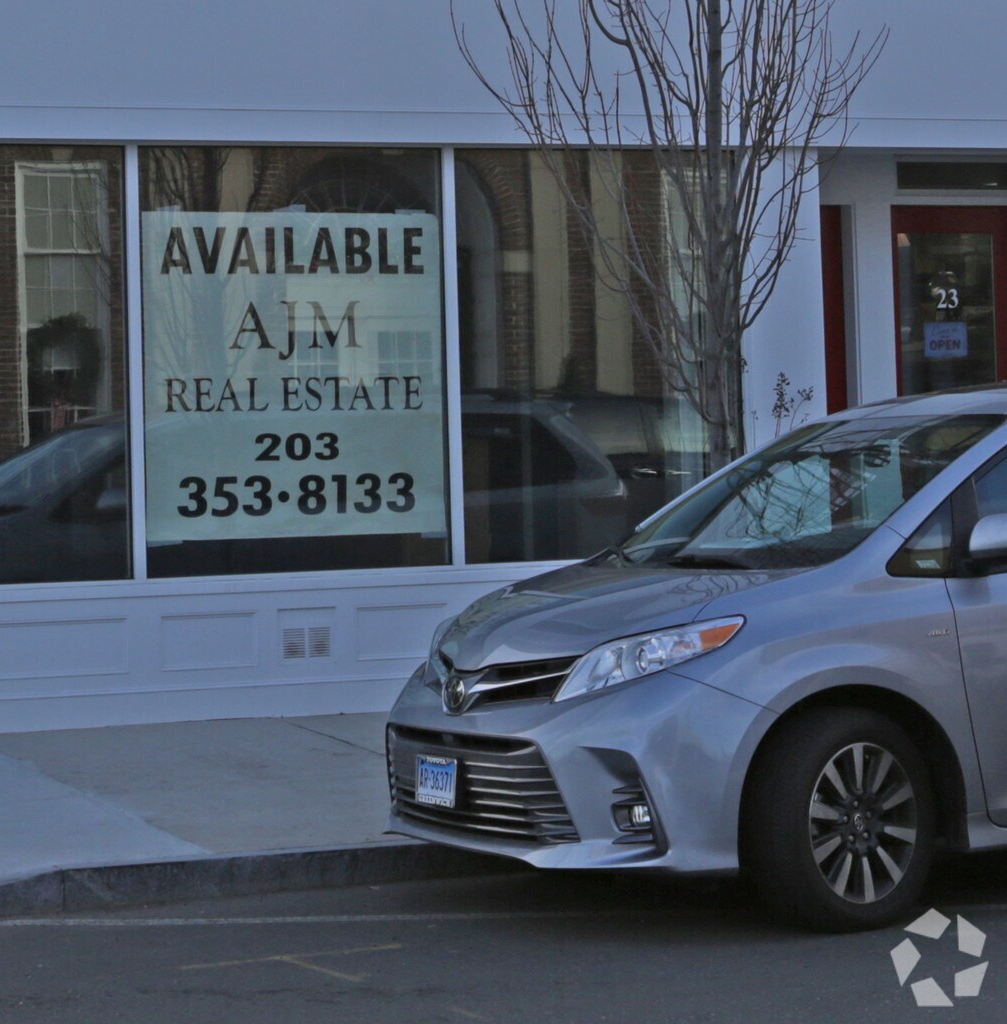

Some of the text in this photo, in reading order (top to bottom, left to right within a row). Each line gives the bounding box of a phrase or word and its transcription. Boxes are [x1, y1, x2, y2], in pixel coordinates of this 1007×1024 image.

[160, 226, 425, 275] AVAILABLE
[936, 288, 959, 309] 23
[229, 300, 362, 361] AJM
[930, 338, 961, 352] OPEN
[164, 375, 424, 413] REAL ESTATE
[254, 432, 340, 462] 203
